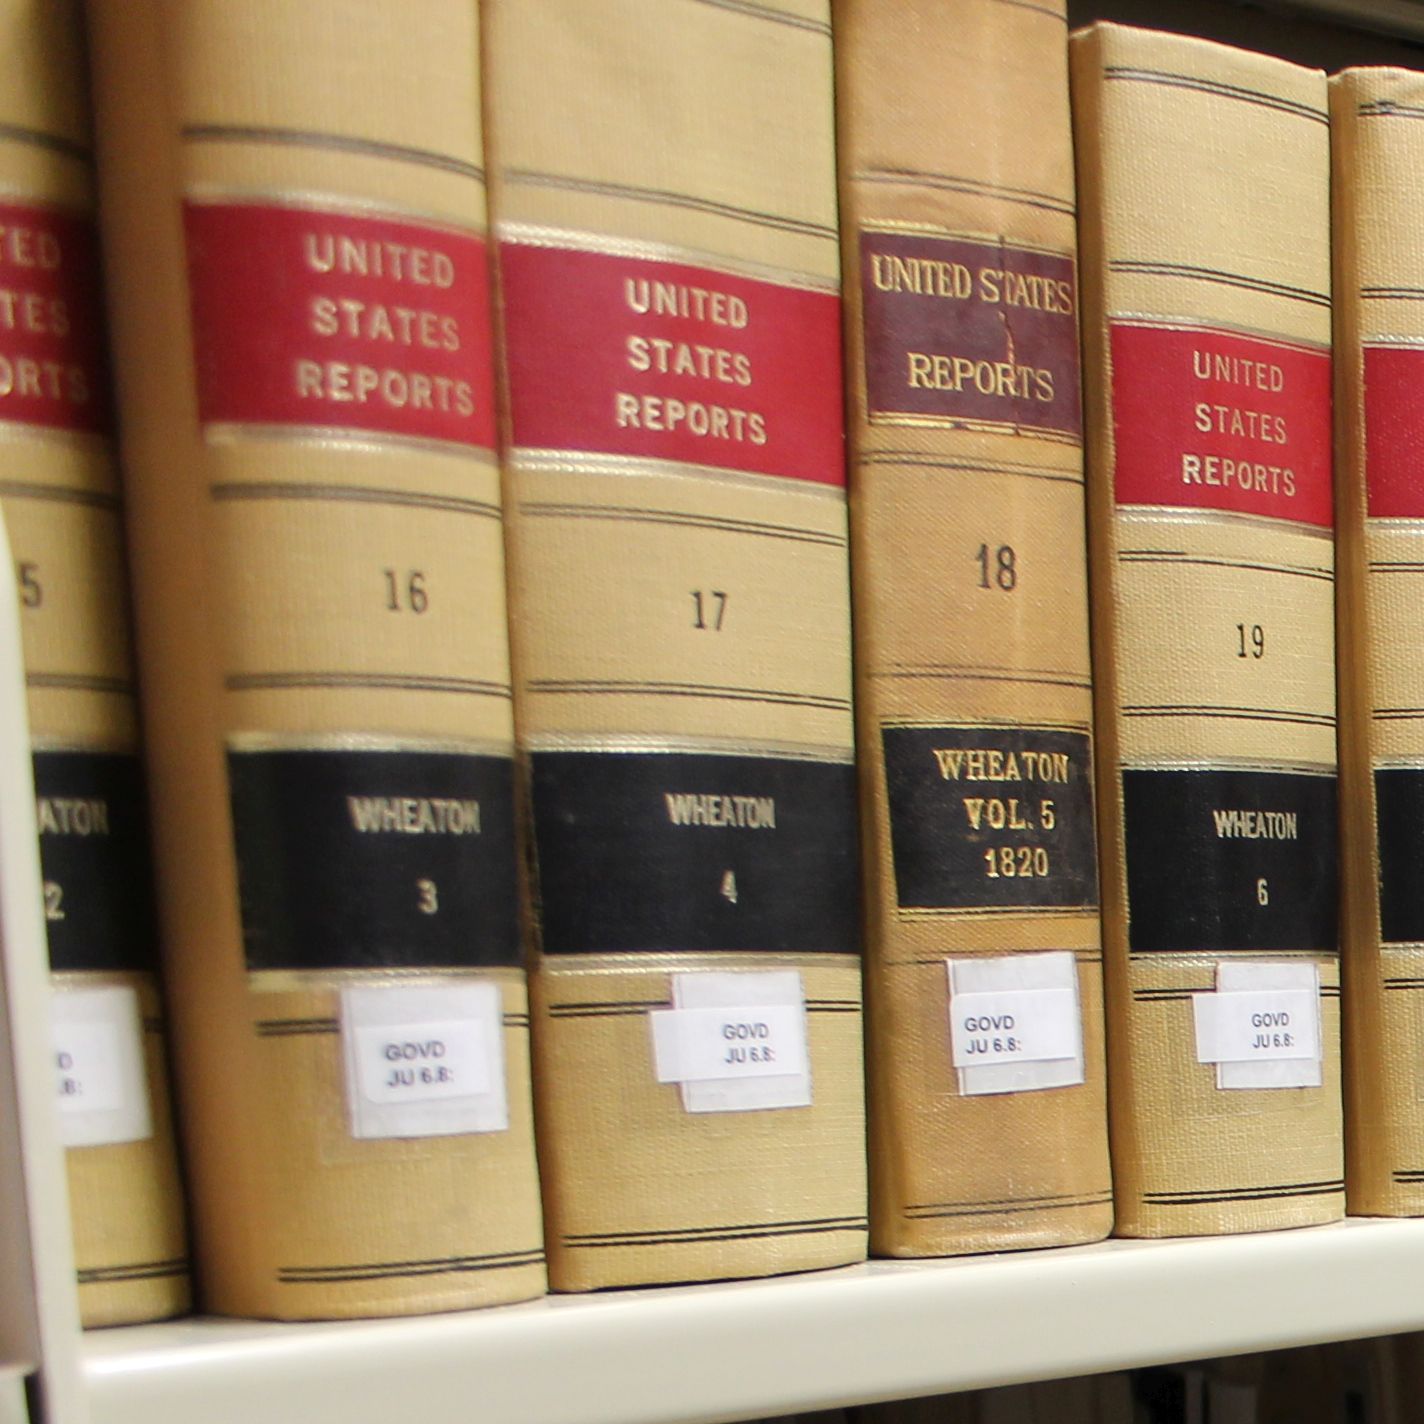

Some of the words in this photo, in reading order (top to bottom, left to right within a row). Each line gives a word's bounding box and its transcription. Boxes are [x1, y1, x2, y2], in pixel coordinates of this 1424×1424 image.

[306, 234, 455, 288] UNITED
[624, 277, 748, 330] UNITED
[871, 254, 972, 302] UNITED
[980, 268, 1072, 316] STATES
[309, 295, 461, 352] STATES
[626, 336, 752, 387] STATES
[907, 351, 1055, 402] REPORTS
[1194, 350, 1284, 392] UNITED
[295, 360, 475, 416] REPORTS
[615, 394, 767, 446] REPORTS
[1195, 404, 1287, 444] STATES
[1182, 455, 1295, 497] REPORTS
[975, 545, 1017, 591] 18
[383, 570, 428, 615] 16
[691, 591, 728, 631] 17
[1236, 625, 1264, 659] 19
[934, 750, 1070, 784] WHEATON
[348, 795, 480, 836] WHEATON
[664, 793, 775, 830] WHEATON
[963, 798, 1034, 830] VOL.
[1041, 801, 1055, 830] 5
[1213, 810, 1298, 840] WHEATON
[984, 847, 1049, 878] 1820
[44, 882, 64, 920] 2
[417, 881, 437, 916] 3
[721, 870, 738, 905] 4
[1257, 879, 1268, 905] 6
[723, 1022, 769, 1040] GOVD
[964, 1015, 1014, 1032] GOVD
[1251, 1012, 1289, 1029] GOVD
[384, 1040, 447, 1063] GOVD
[725, 1047, 747, 1064] JU
[750, 1046, 776, 1063] 6.8:
[965, 1037, 990, 1054] JU
[994, 1037, 1021, 1053] 6.8:
[1252, 1034, 1270, 1049] JU
[1273, 1033, 1294, 1048] 6.8:
[387, 1068, 415, 1089] JU
